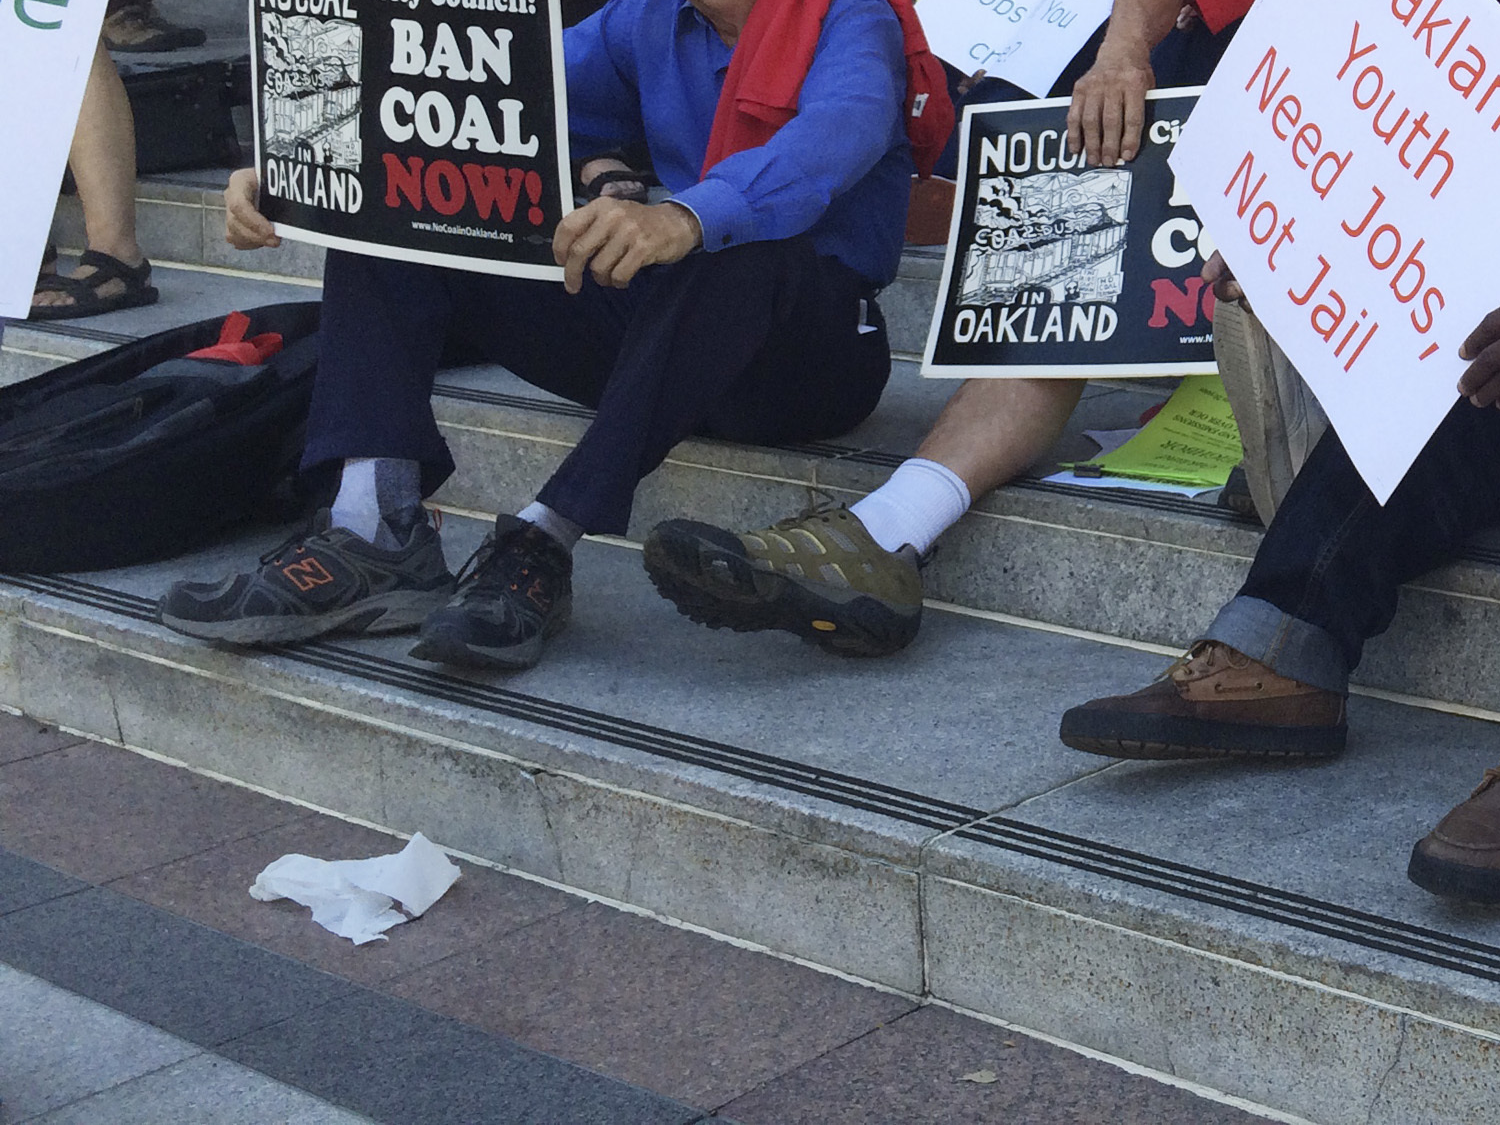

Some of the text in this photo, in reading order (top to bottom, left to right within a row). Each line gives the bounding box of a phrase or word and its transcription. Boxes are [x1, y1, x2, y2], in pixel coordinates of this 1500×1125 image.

[390, 18, 513, 86] BAN
[380, 86, 539, 158] COAL
[1336, 20, 1456, 200] Youth
[267, 160, 363, 214] OAKLAND
[297, 146, 312, 163] IN
[979, 132, 1031, 175] NO
[382, 152, 544, 226] NOW!
[1244, 45, 1447, 362] Need Jobs,
[1223, 150, 1380, 374] Not Jail
[954, 304, 1119, 343] OAKLAND
[1022, 291, 1045, 305] IN
